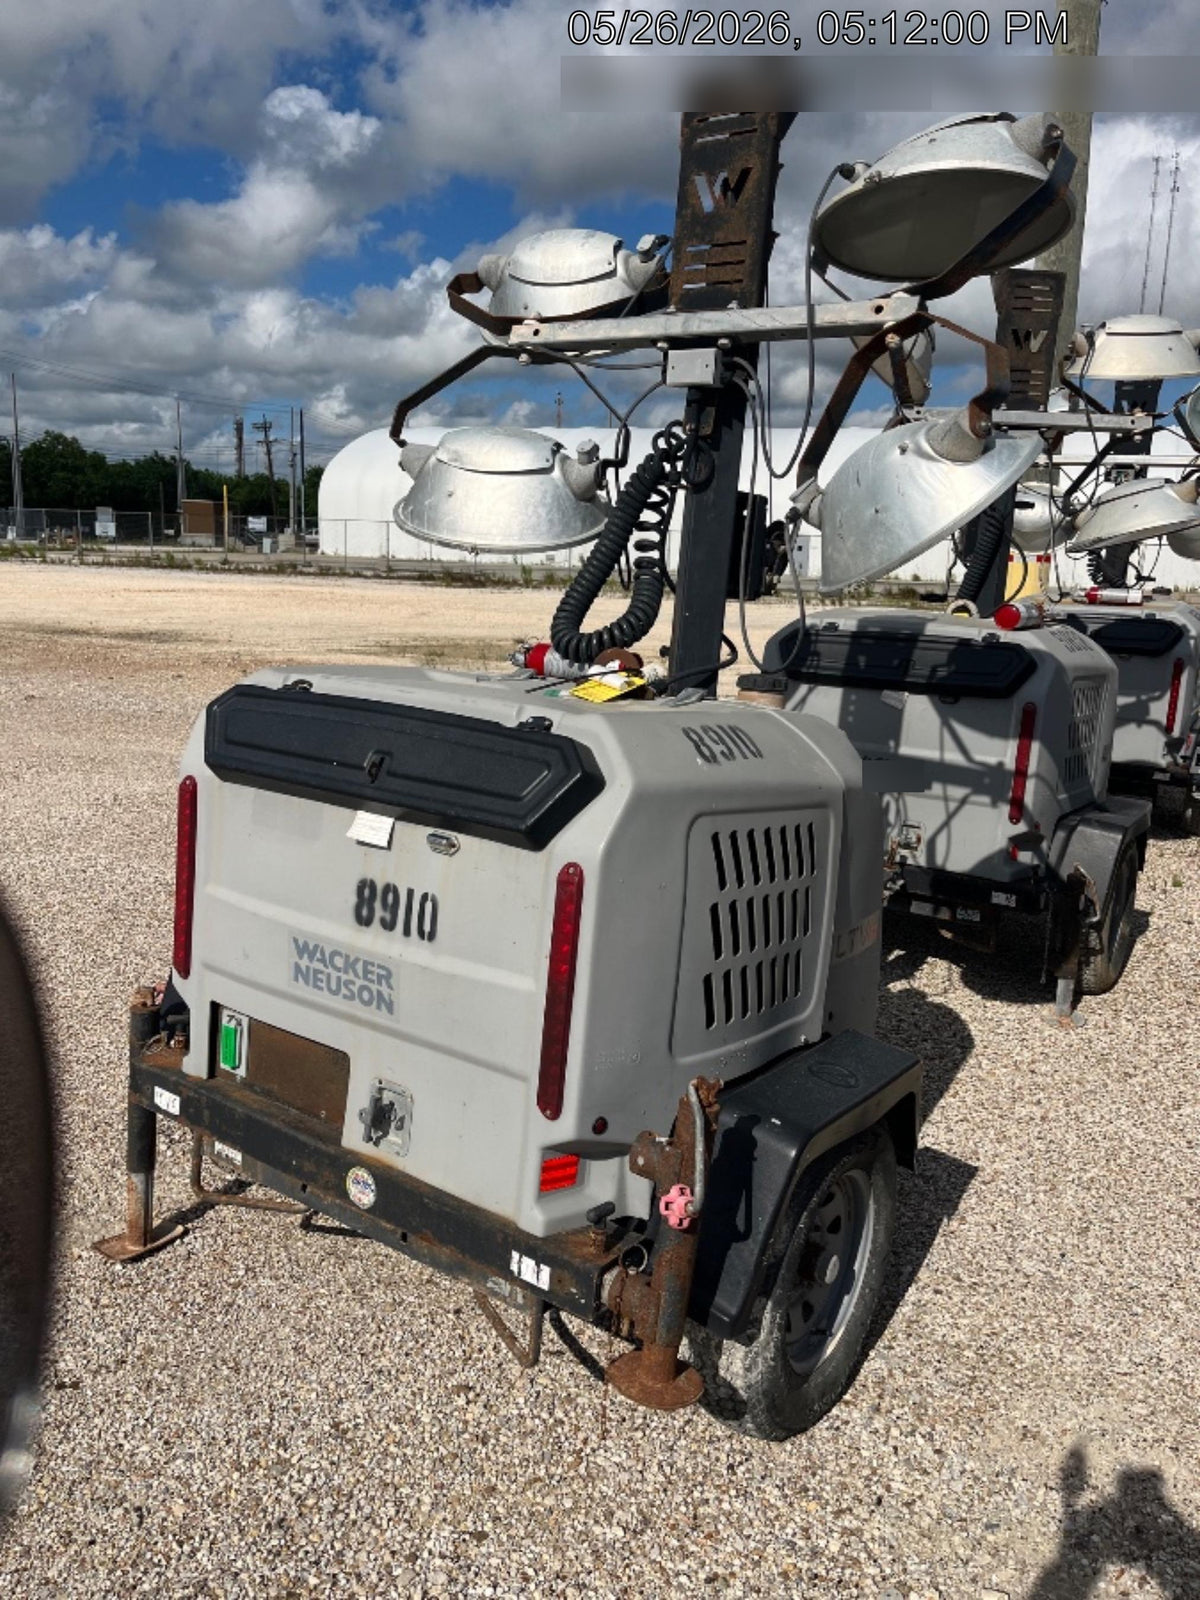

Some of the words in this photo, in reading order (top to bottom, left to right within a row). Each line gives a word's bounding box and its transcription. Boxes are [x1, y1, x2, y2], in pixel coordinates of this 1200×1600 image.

[681, 724, 763, 765] 8910
[354, 877, 439, 943] 8910
[292, 936, 395, 991] WACKER
[292, 961, 395, 1015] NEUSON
